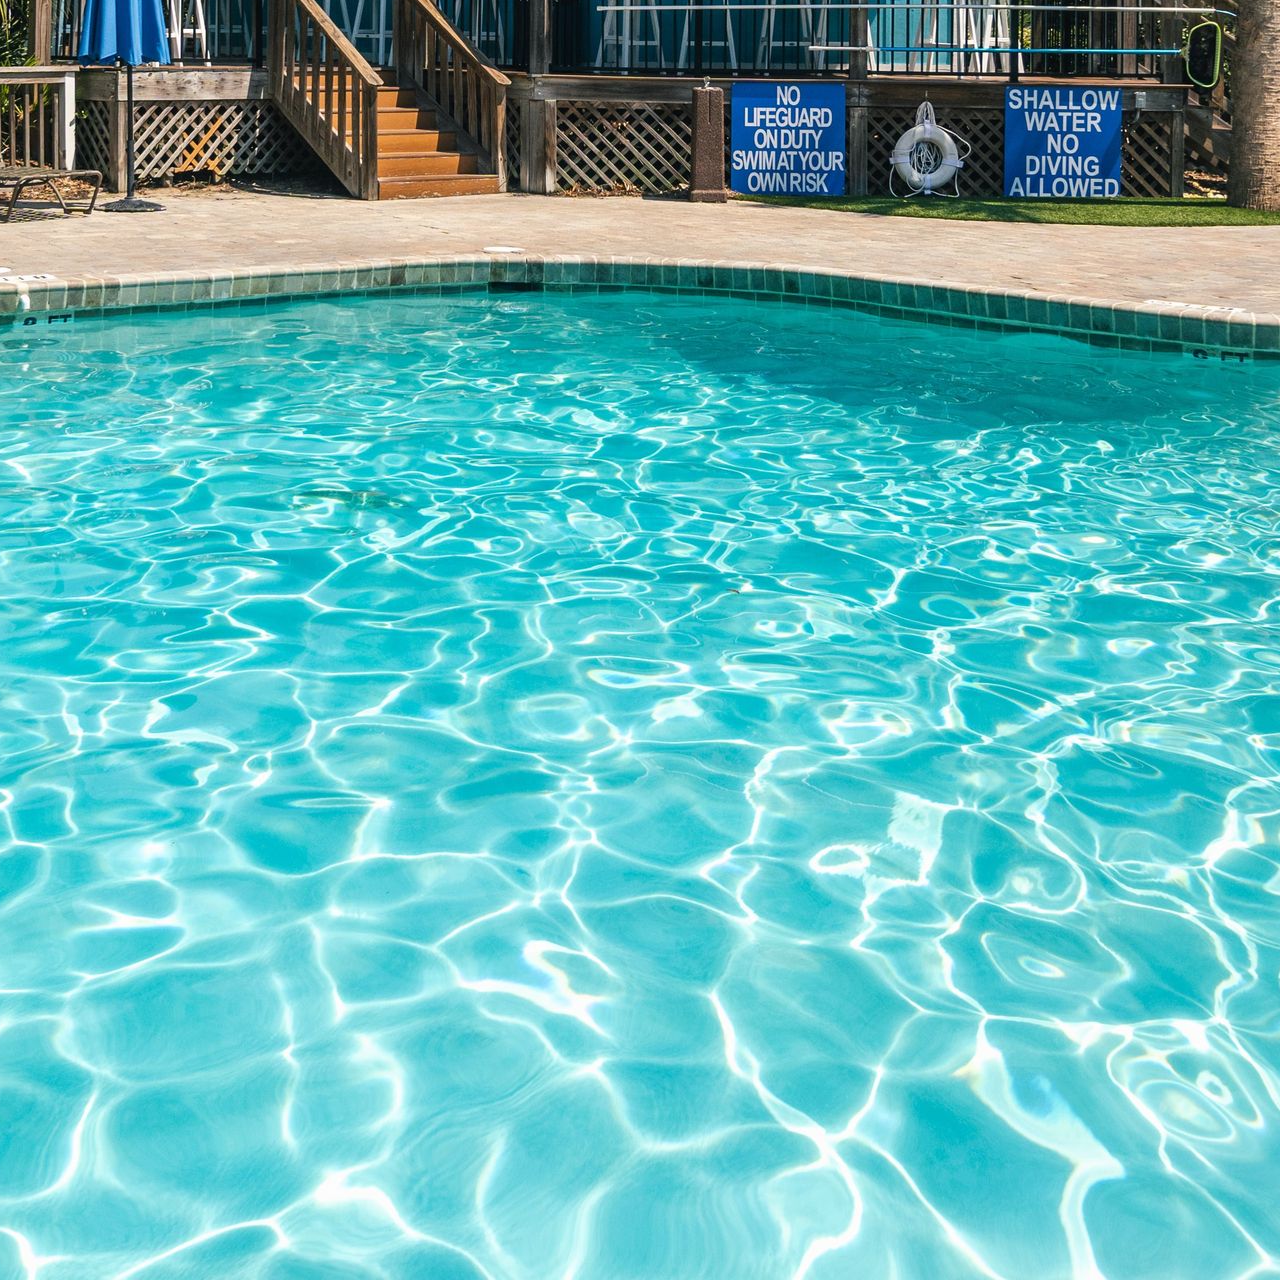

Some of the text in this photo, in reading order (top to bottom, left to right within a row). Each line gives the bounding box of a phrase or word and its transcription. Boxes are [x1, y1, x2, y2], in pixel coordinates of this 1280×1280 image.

[776, 85, 801, 106] NO
[1008, 88, 1119, 111] SHALLOW
[744, 107, 833, 128] LIFEGUARD
[1024, 111, 1102, 132] WATER
[754, 128, 823, 149] ON DUTY
[1047, 133, 1079, 154] NO
[732, 150, 844, 171] SWIM AT YOUR
[1025, 155, 1100, 176] DIVING
[747, 172, 829, 193] OWN RISK
[1009, 176, 1119, 197] ALLOWED
